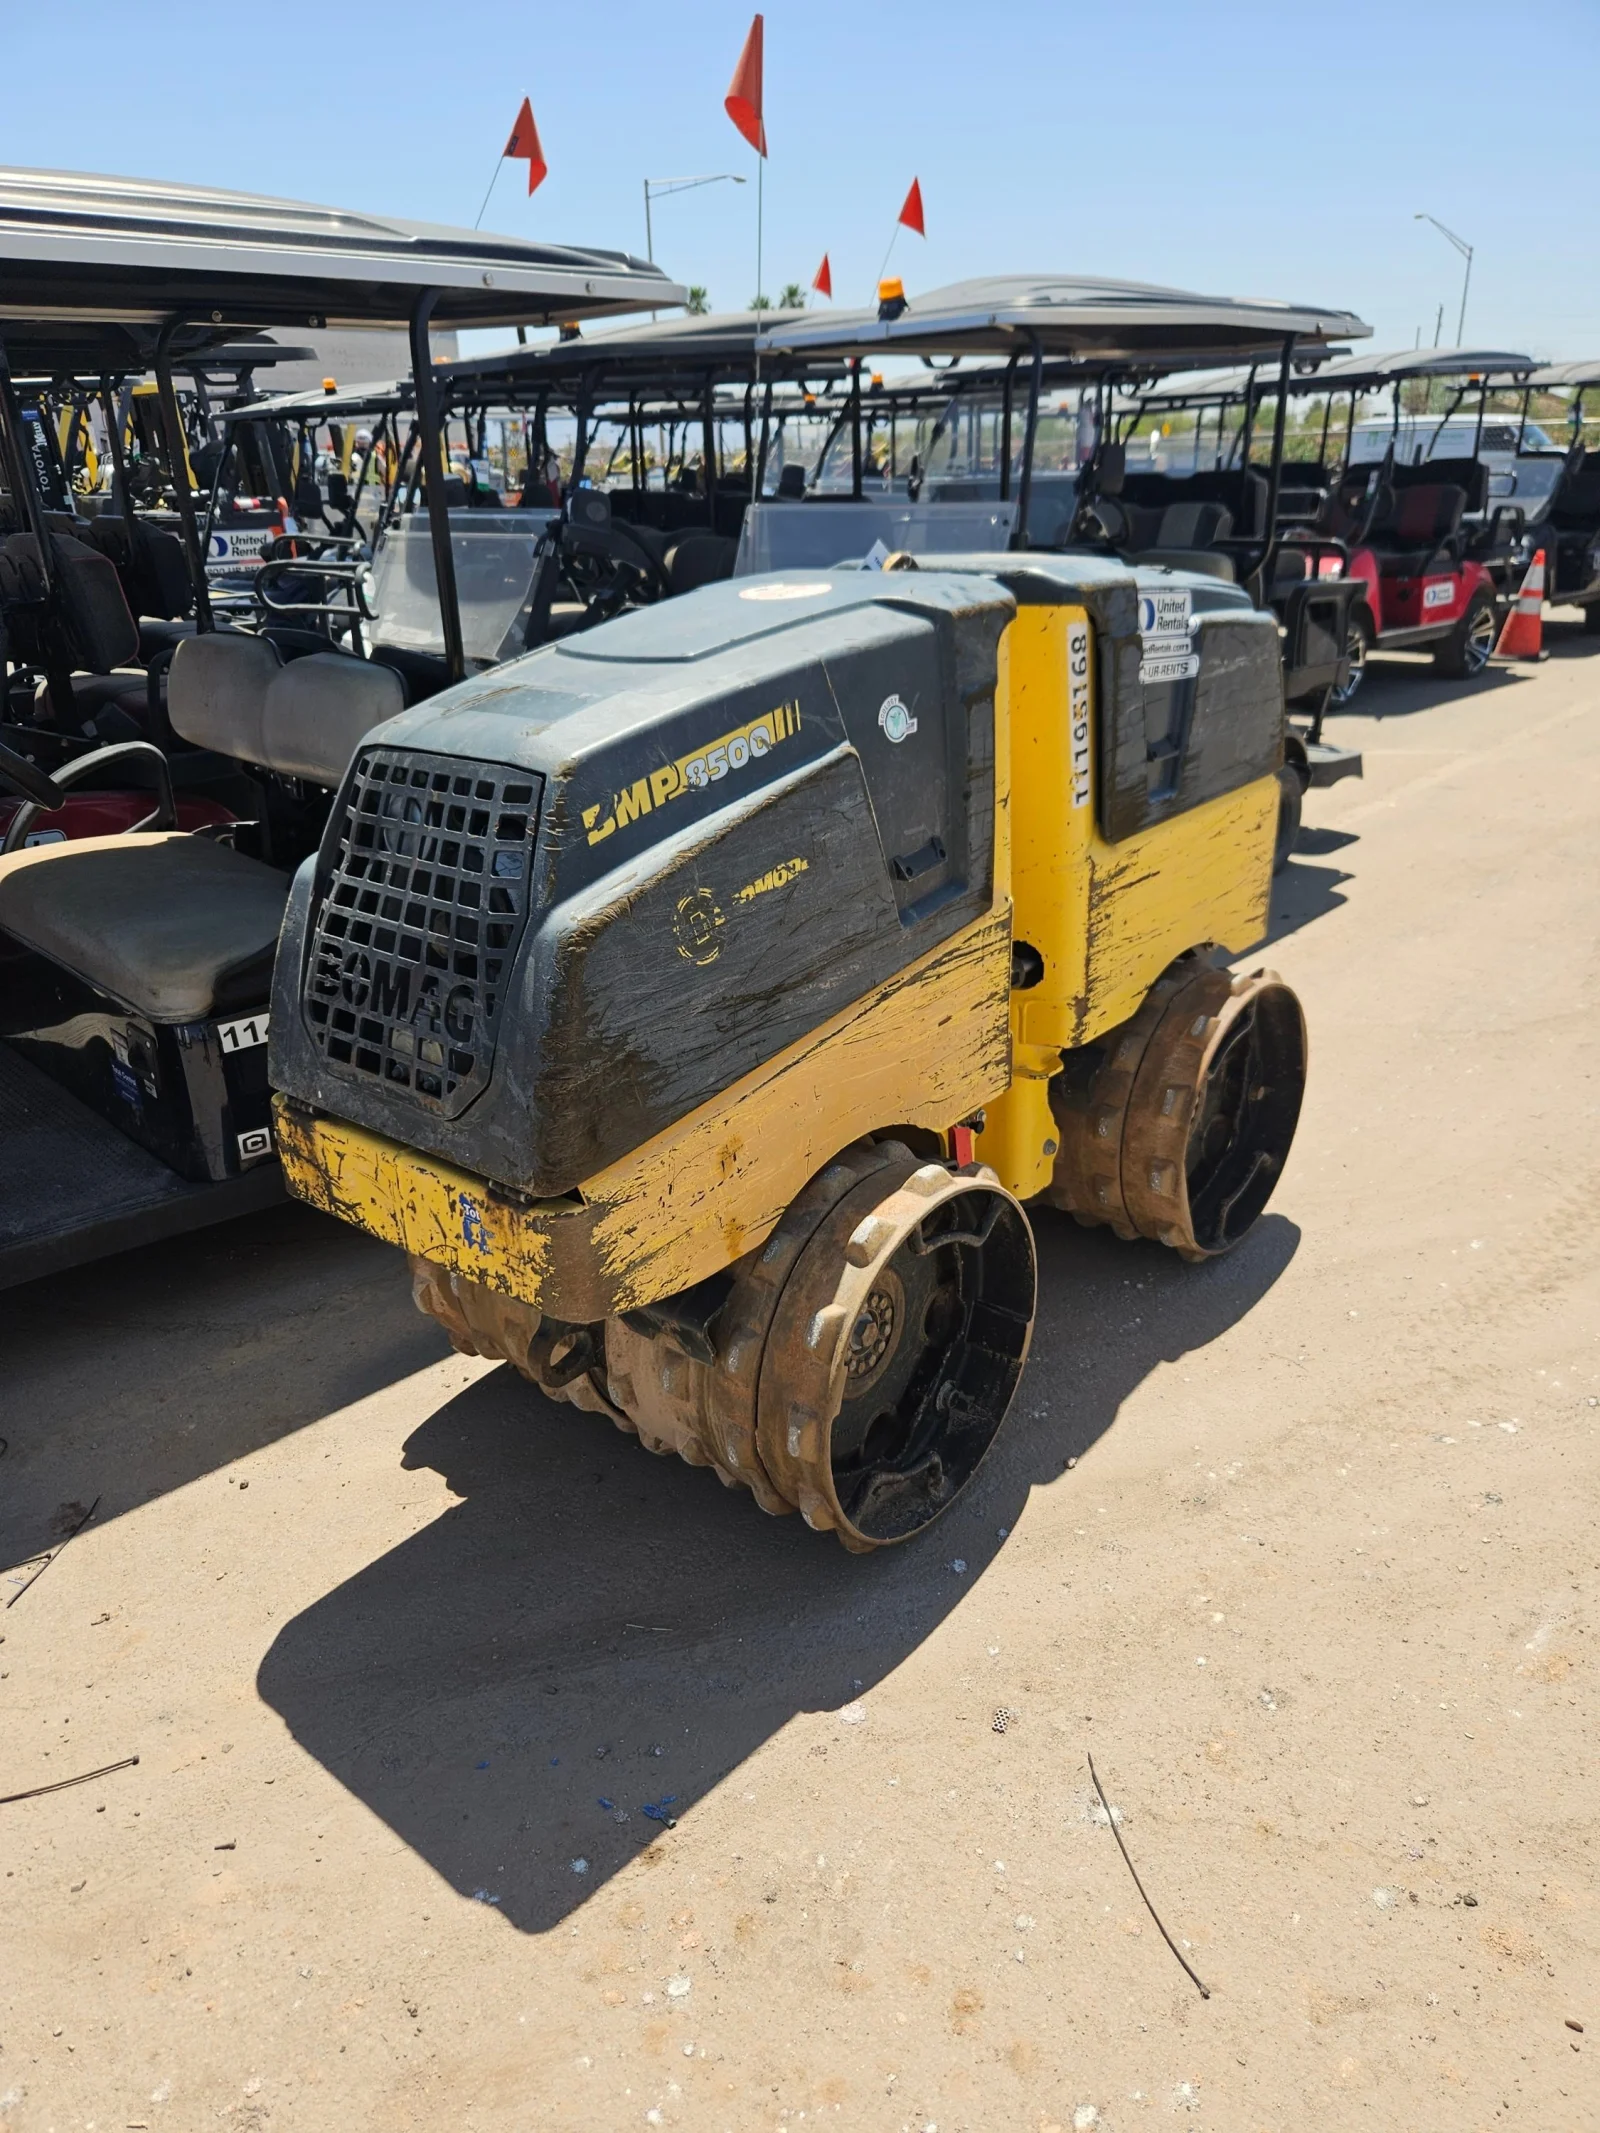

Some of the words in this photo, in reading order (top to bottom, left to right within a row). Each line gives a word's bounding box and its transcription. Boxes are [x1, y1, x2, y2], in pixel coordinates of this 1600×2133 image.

[32, 444, 51, 492] TOYOTA
[230, 534, 267, 546] United
[1157, 597, 1187, 613] United
[1157, 616, 1190, 632] Rentals
[684, 724, 772, 787] 8500
[314, 942, 476, 1042] BOMAG
